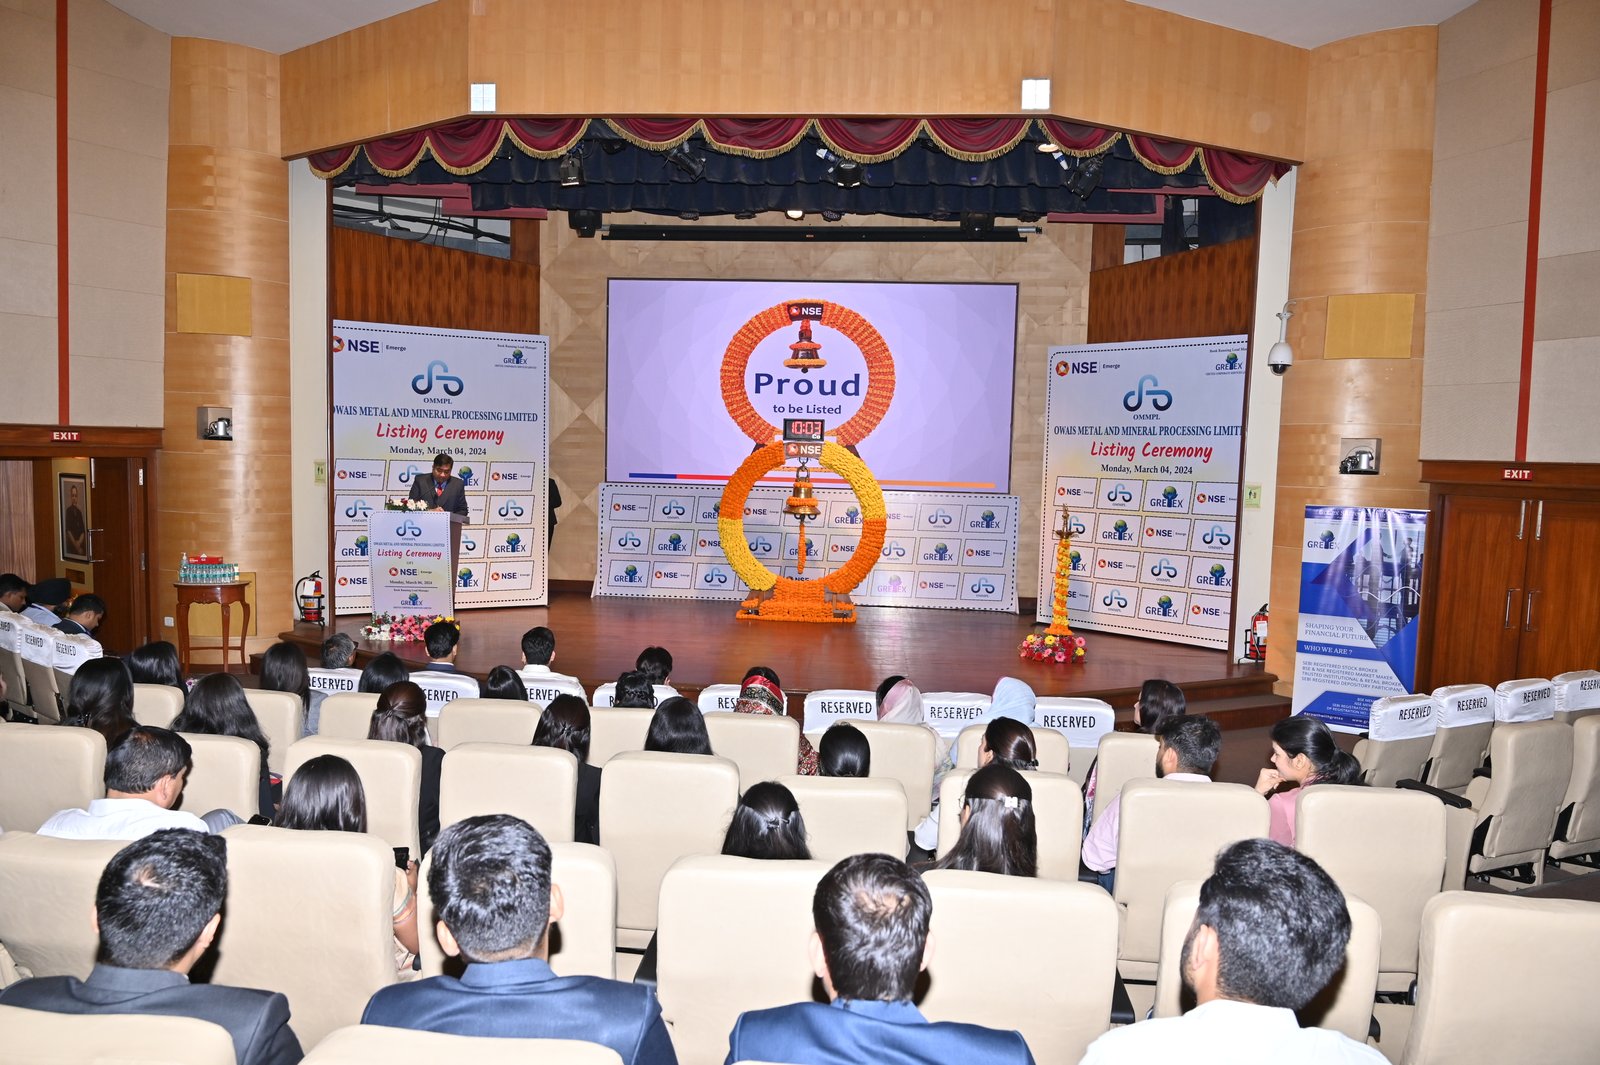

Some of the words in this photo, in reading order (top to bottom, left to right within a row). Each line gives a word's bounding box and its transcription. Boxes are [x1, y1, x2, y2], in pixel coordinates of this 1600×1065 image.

[801, 307, 822, 315] NSE
[348, 339, 380, 353] NSE
[1071, 362, 1097, 374] NSE
[755, 373, 860, 396] Proud
[359, 407, 390, 417] METAL
[391, 408, 409, 417] AND
[412, 409, 450, 419] MINERAL
[452, 410, 502, 421] PROCESSING
[504, 412, 538, 421] LIMITED
[773, 404, 785, 413] to
[788, 404, 803, 413] be
[806, 405, 842, 415] Listed
[376, 422, 427, 443] Listing
[434, 424, 504, 445] Ceremony
[792, 421, 821, 434] 10:03
[1054, 426, 1076, 435] OWAIS
[1078, 426, 1102, 435] METAL
[1104, 426, 1120, 435] AND
[1122, 426, 1157, 436] MINERAL
[1159, 426, 1211, 436] PROCESSING
[53, 432, 78, 441] EXIT
[390, 446, 424, 456] Monday,
[427, 446, 453, 455] March
[455, 447, 467, 456] 04,
[800, 446, 821, 454] NSE
[1091, 441, 1135, 462] Listing
[1142, 442, 1213, 463] Ceremony
[1101, 464, 1131, 474] Monday,
[1160, 466, 1172, 474] 04,
[1174, 466, 1192, 474] 2024
[1504, 470, 1530, 479] EXIT
[378, 549, 402, 559] Listing
[406, 550, 441, 560] Ceremony
[1203, 608, 1220, 616] NSE
[1305, 623, 1334, 631] SHAPING
[56, 642, 76, 656] RESERVED
[1523, 688, 1550, 703] RESERVED
[821, 702, 872, 714] RESERVED
[1457, 697, 1488, 711] RESERVED
[930, 707, 982, 720] RESERVED
[1399, 706, 1431, 720] RESERVED
[1044, 716, 1096, 728] RESERVED
